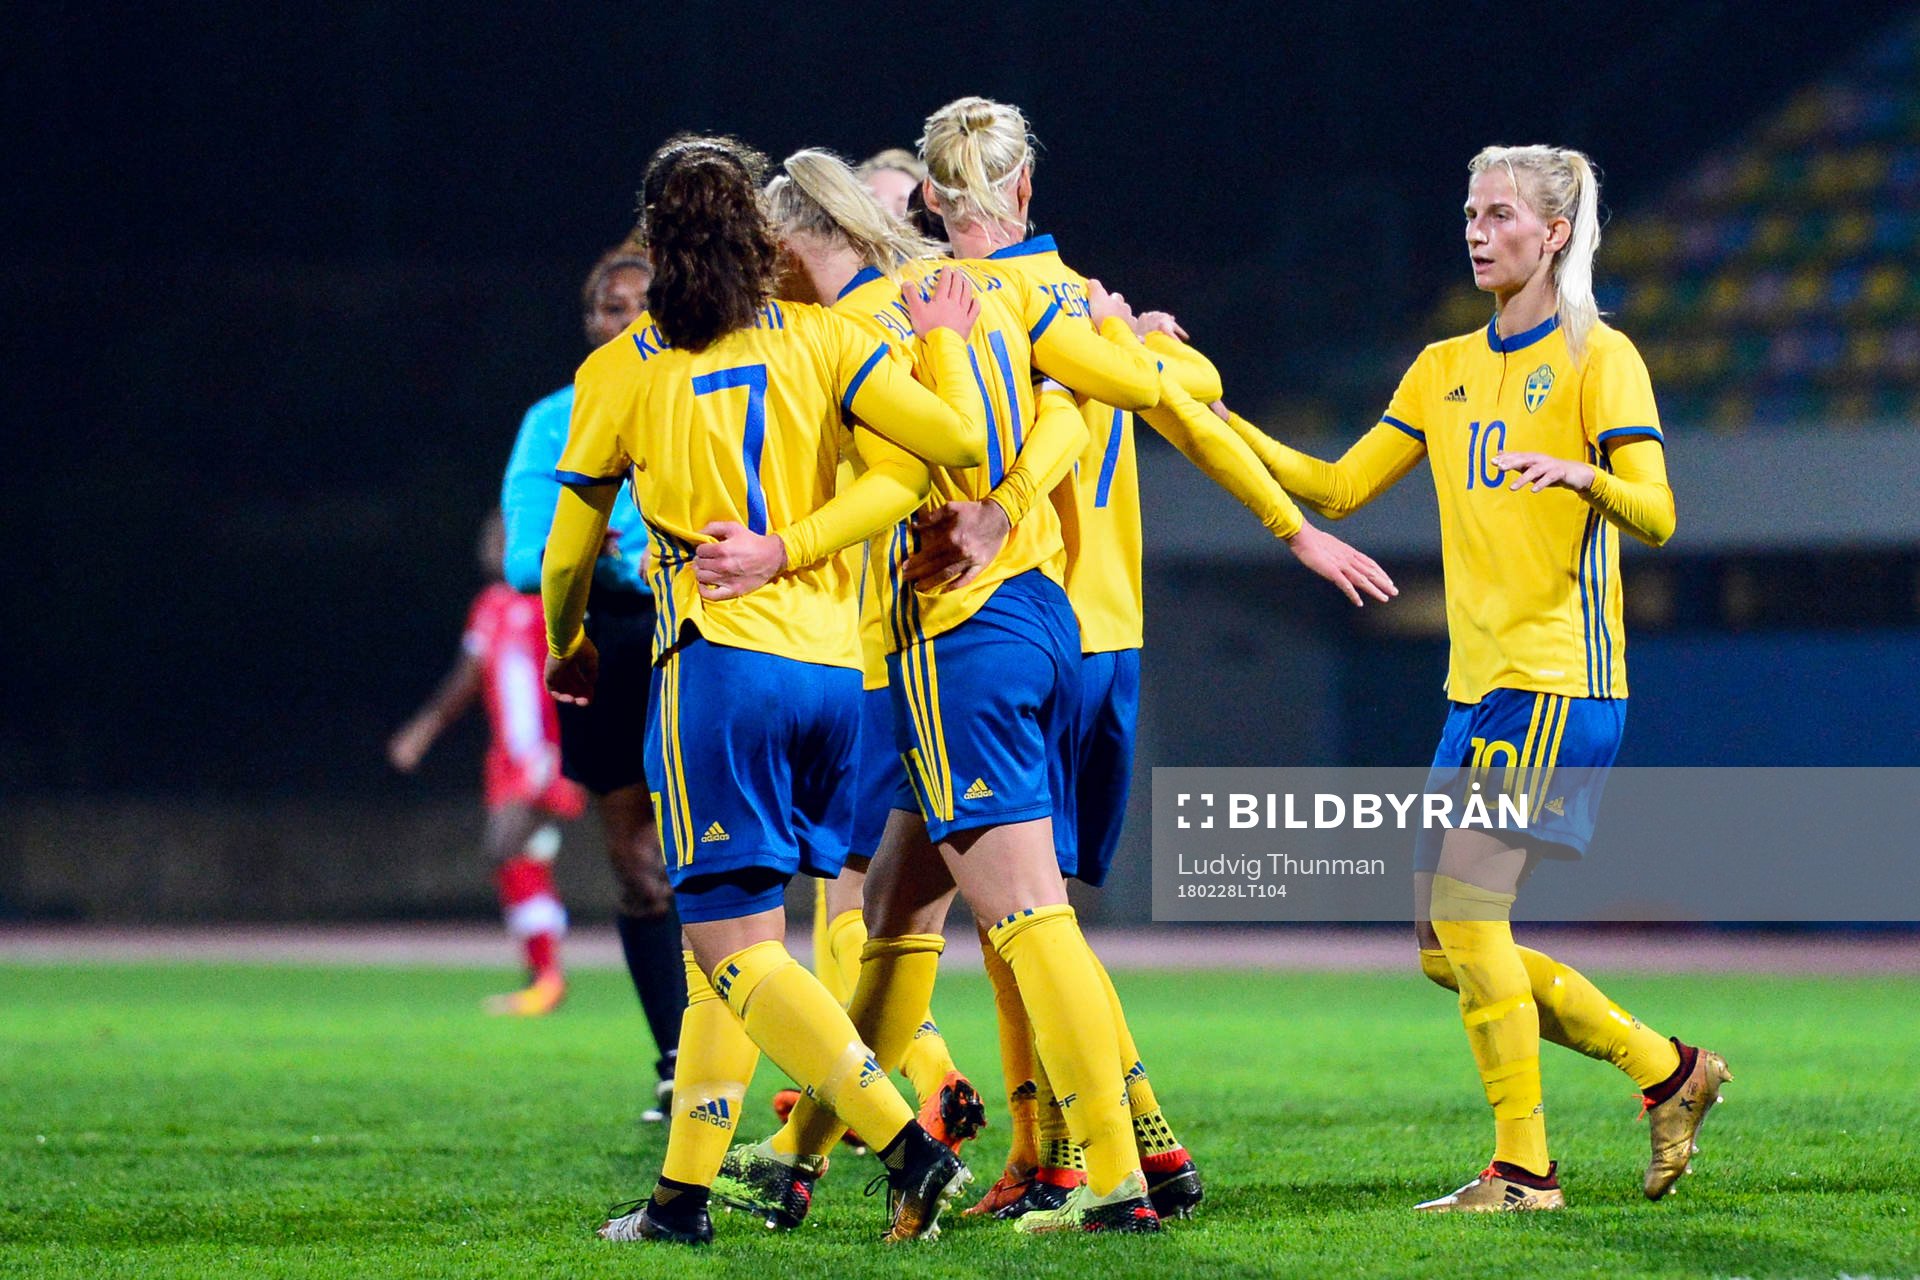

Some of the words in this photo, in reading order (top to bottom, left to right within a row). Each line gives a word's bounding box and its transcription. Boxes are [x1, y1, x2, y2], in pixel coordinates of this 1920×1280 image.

[691, 363, 768, 536] 7
[1466, 420, 1506, 490] 10
[963, 789, 994, 800] adidas
[1463, 737, 1518, 810] 10
[700, 833, 731, 844] adidas
[689, 1110, 733, 1131] adidas
